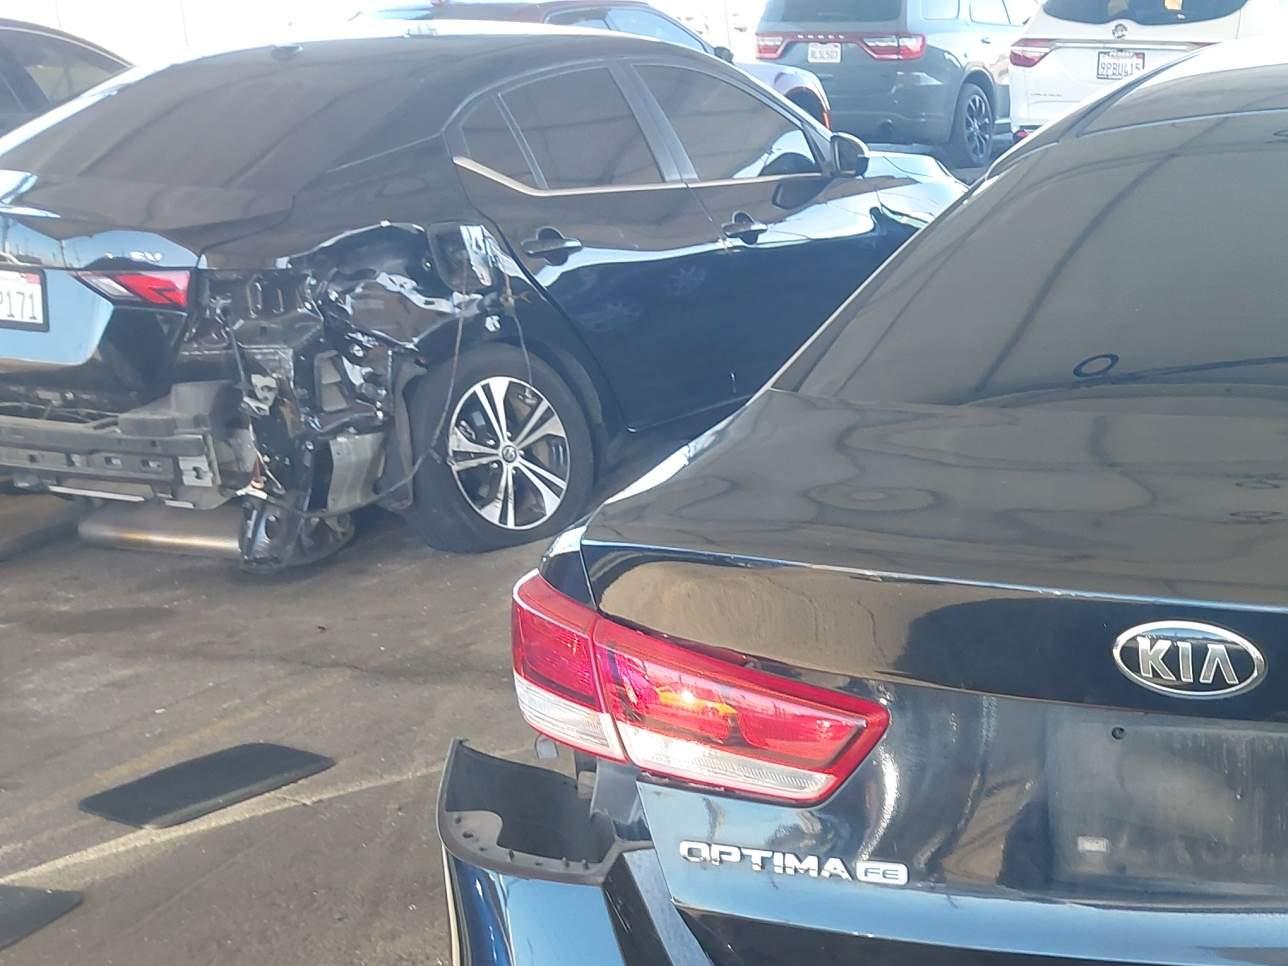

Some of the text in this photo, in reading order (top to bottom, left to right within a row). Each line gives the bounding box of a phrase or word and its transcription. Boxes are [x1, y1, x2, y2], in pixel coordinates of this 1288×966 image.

[1136, 636, 1239, 684] KIA
[679, 840, 901, 882] OPTIMA FE
